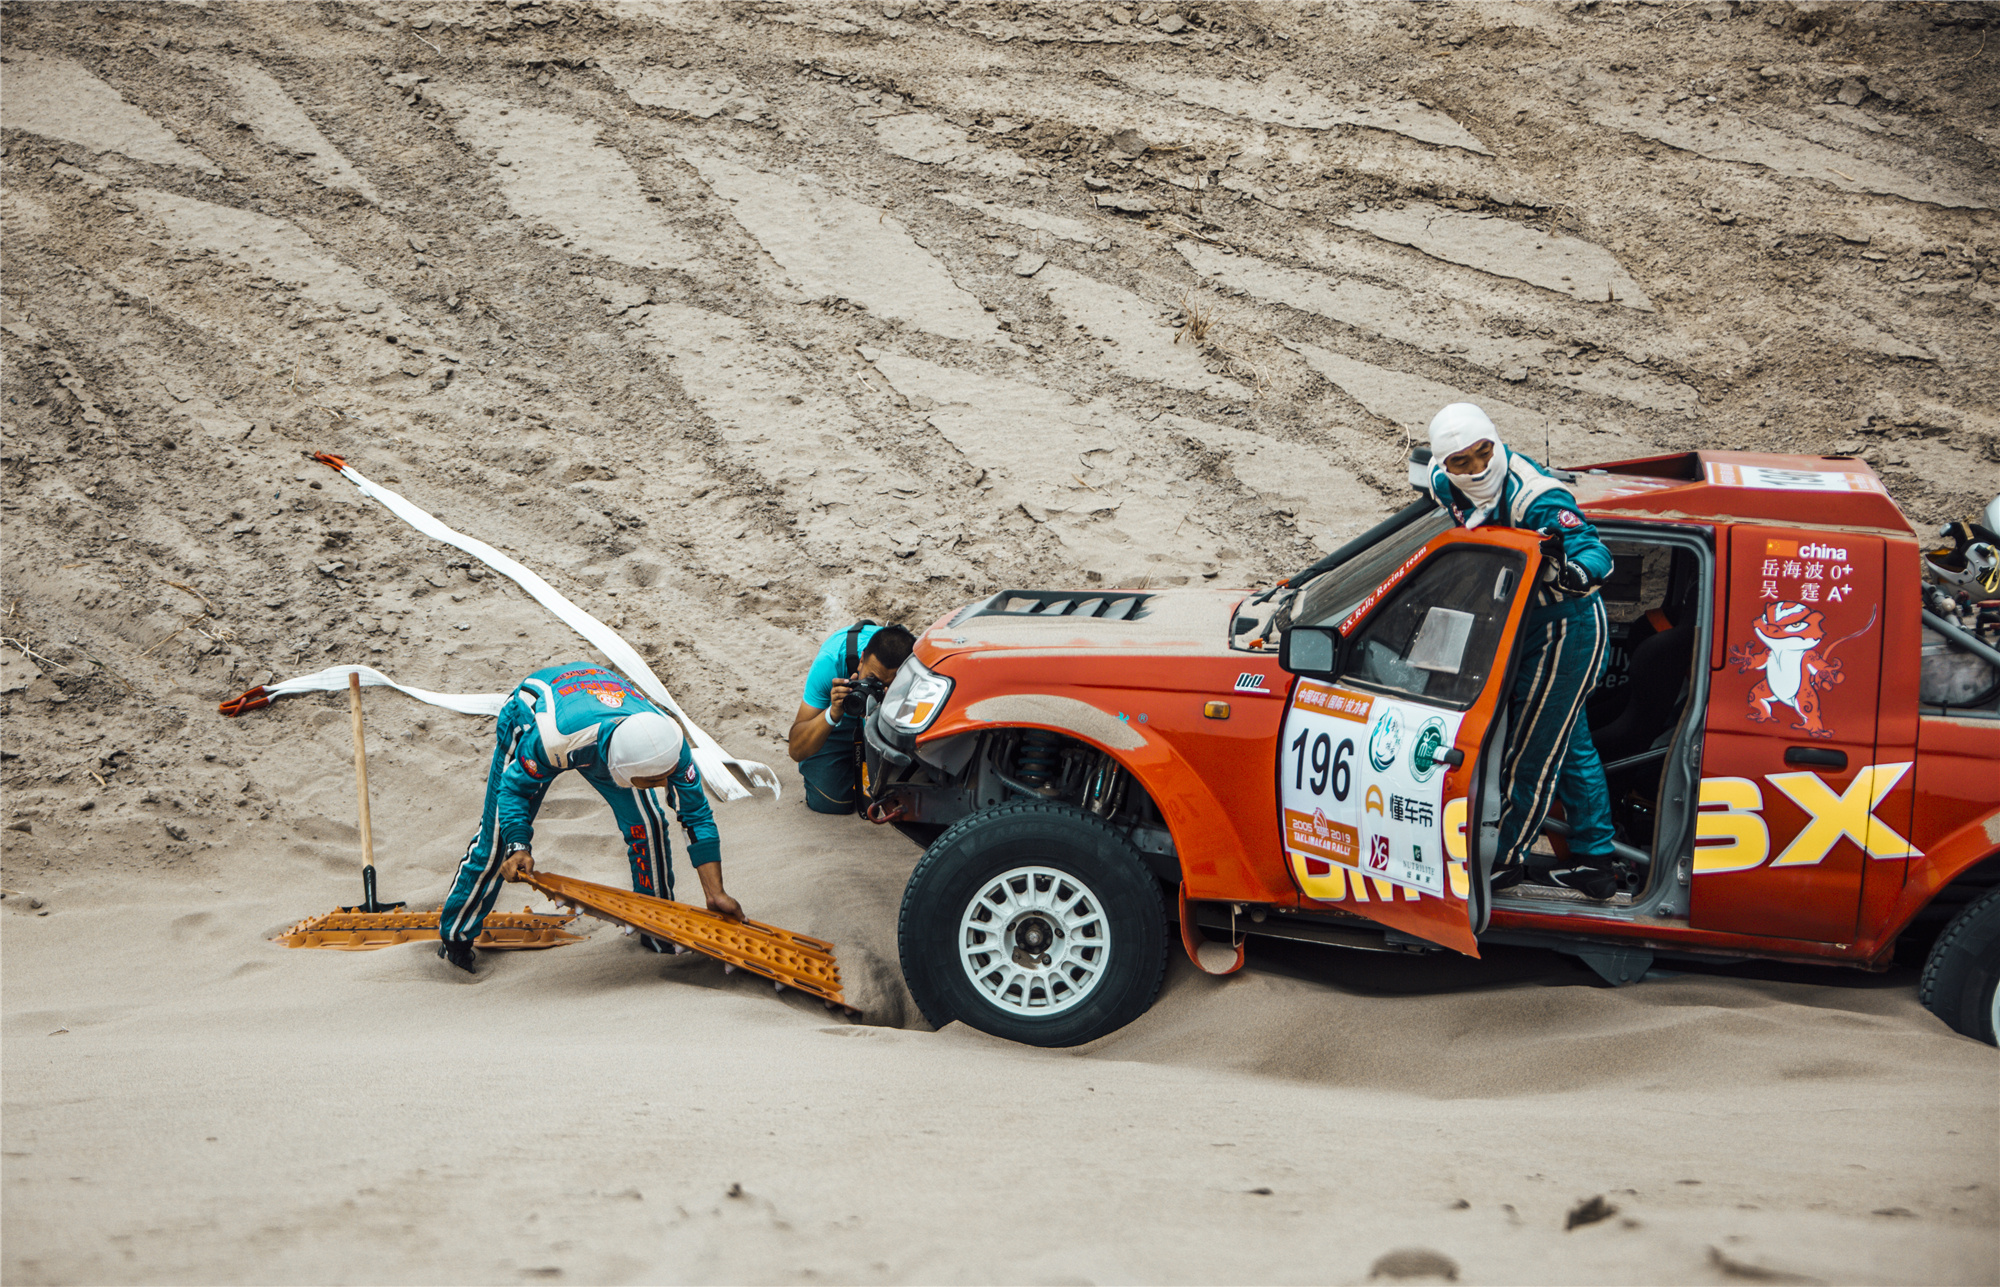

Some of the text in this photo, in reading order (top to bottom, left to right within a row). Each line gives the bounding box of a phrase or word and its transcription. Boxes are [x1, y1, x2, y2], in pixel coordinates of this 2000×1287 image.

[1799, 542, 1847, 560] china
[1376, 566, 1405, 598] Racing
[1405, 546, 1428, 568] team
[1761, 558, 1825, 580] 岳海波
[1826, 583, 1853, 602] A+
[1291, 727, 1355, 802] 196
[1389, 793, 1434, 828] 懂车帝
[1292, 818, 1351, 844] 2005 2019
[1293, 831, 1351, 856] TAKLIMAKAN RALLY
[1403, 860, 1436, 876] NUTRILITE
